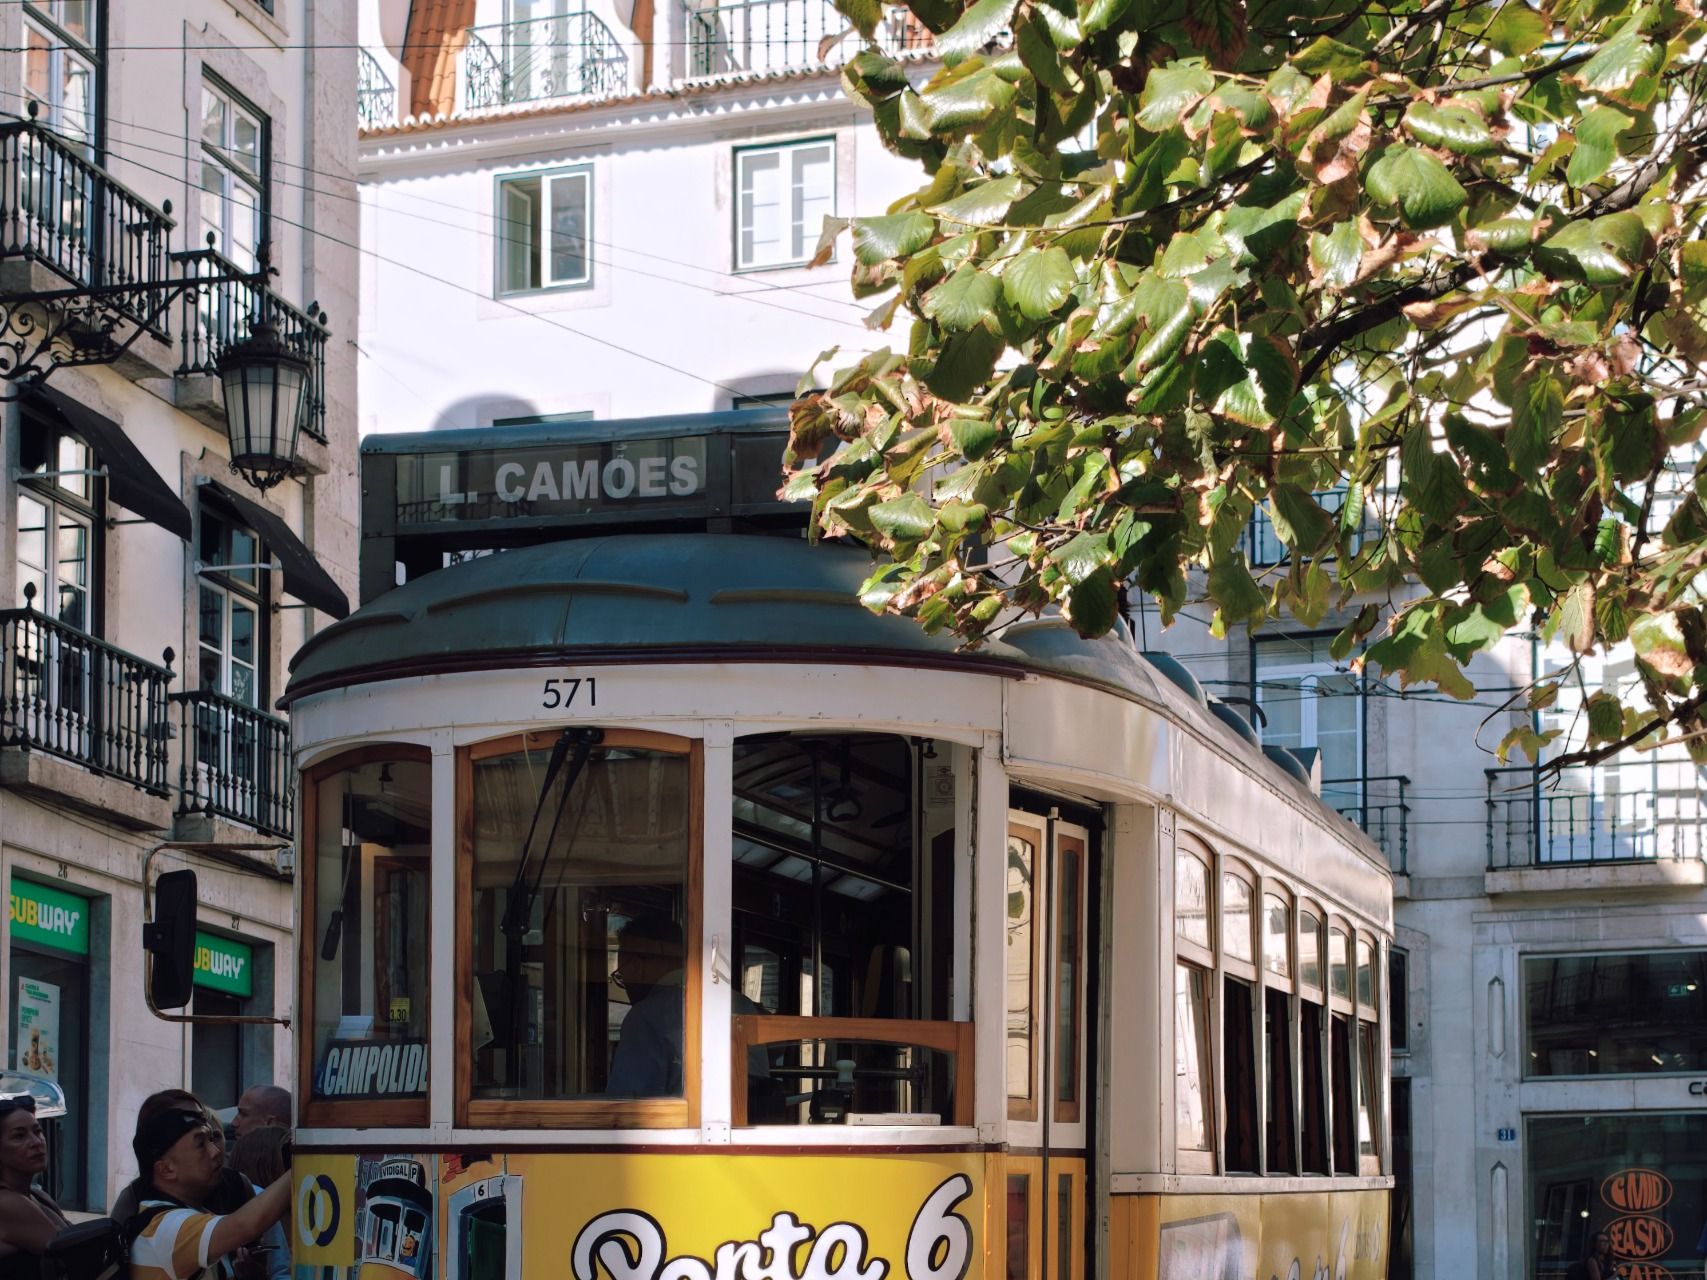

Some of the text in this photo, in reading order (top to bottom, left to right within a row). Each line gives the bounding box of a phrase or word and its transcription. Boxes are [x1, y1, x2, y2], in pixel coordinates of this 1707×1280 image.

[440, 465, 477, 504] L.
[542, 677, 596, 709] 571
[58, 863, 68, 879] 26
[231, 916, 241, 931] 27
[193, 946, 245, 979] UBWAY
[1500, 1129, 1511, 1140] 31
[382, 1164, 407, 1177] VIDIGAL
[411, 1168, 416, 1179] P
[477, 1184, 485, 1196] 6
